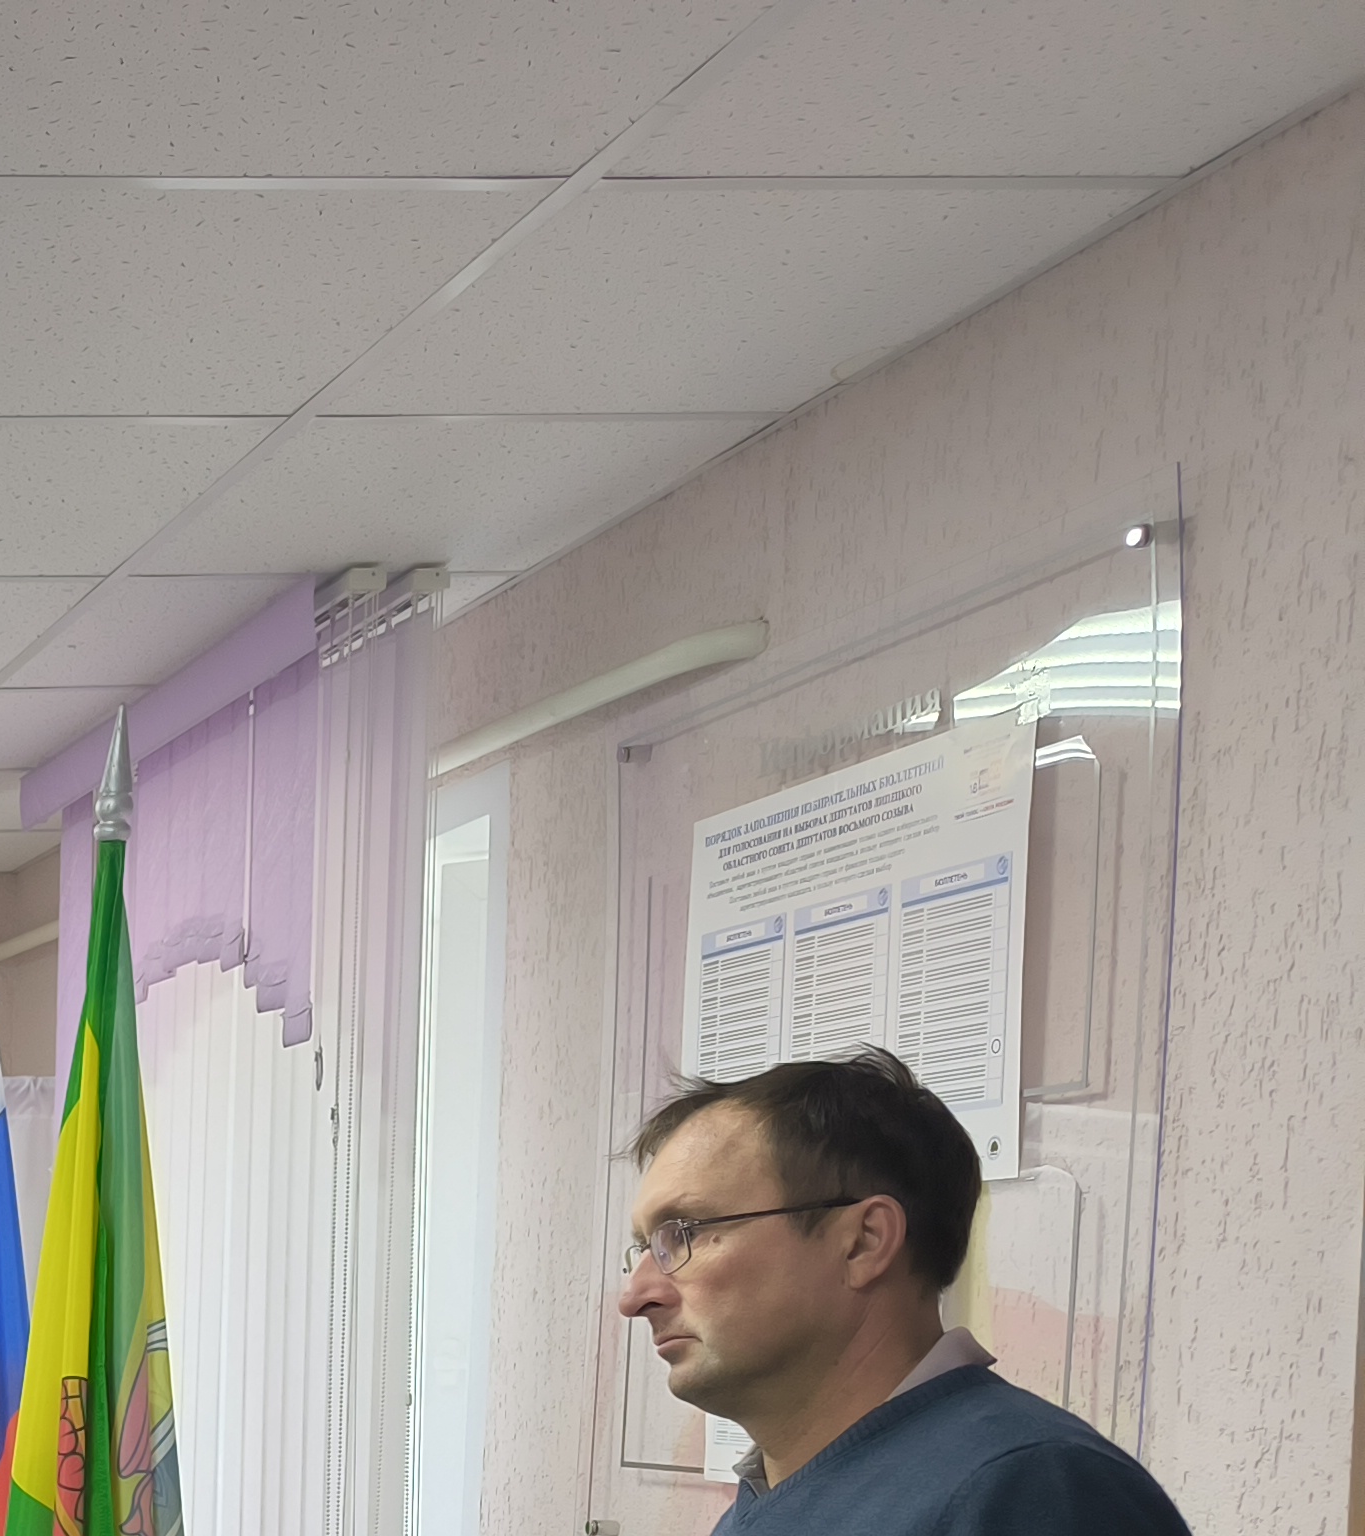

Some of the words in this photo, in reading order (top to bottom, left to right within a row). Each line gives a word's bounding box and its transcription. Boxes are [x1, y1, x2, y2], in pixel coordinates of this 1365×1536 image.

[705, 825, 742, 847] ПОРЯДОК
[740, 805, 799, 835] ЗАПОЛНЕНИЯ
[800, 782, 878, 816] ИЗБИРАТЕЛЬНЫХ
[879, 755, 944, 788] БЮЛЛЕТЕНЕЙ
[732, 830, 783, 855] ГОЛОСОВАНИЯ
[783, 826, 794, 840] НА
[794, 815, 827, 834] ВЫБОРАХ
[828, 800, 873, 825] ДЕПУТАТОВ
[874, 783, 923, 809] ЛИПЕЦКОГО
[723, 849, 768, 872] ОБЛАСТНОГО
[768, 841, 795, 860] СОВЕТА
[796, 827, 837, 851] ДЕПУТАТОВ
[838, 814, 881, 839] ВОСЬМОГО
[881, 803, 914, 823] СОЗЫВА
